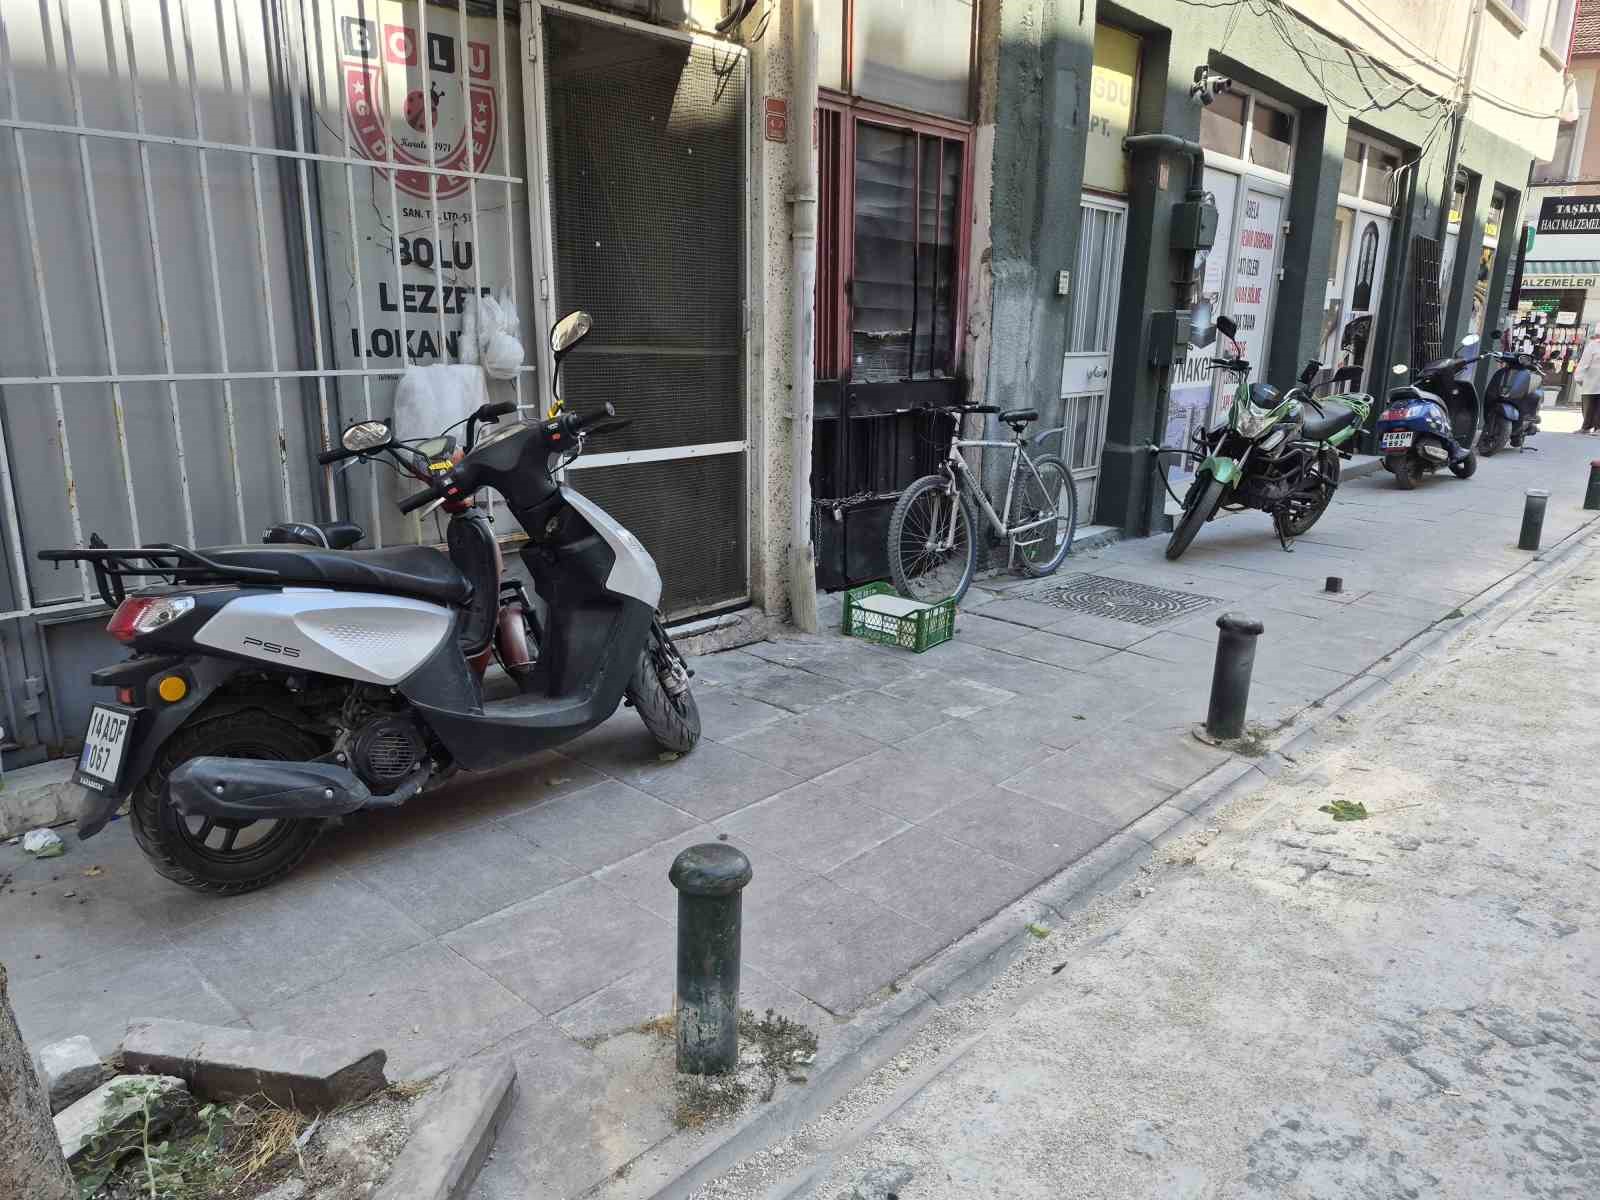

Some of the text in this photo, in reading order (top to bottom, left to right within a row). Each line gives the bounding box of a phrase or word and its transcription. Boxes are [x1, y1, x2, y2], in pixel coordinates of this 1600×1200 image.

[346, 19, 488, 77] BOLU
[399, 236, 473, 271] BOLU
[351, 327, 464, 359] LOKAN
[242, 636, 301, 658] PSS
[88, 743, 111, 774] 067
